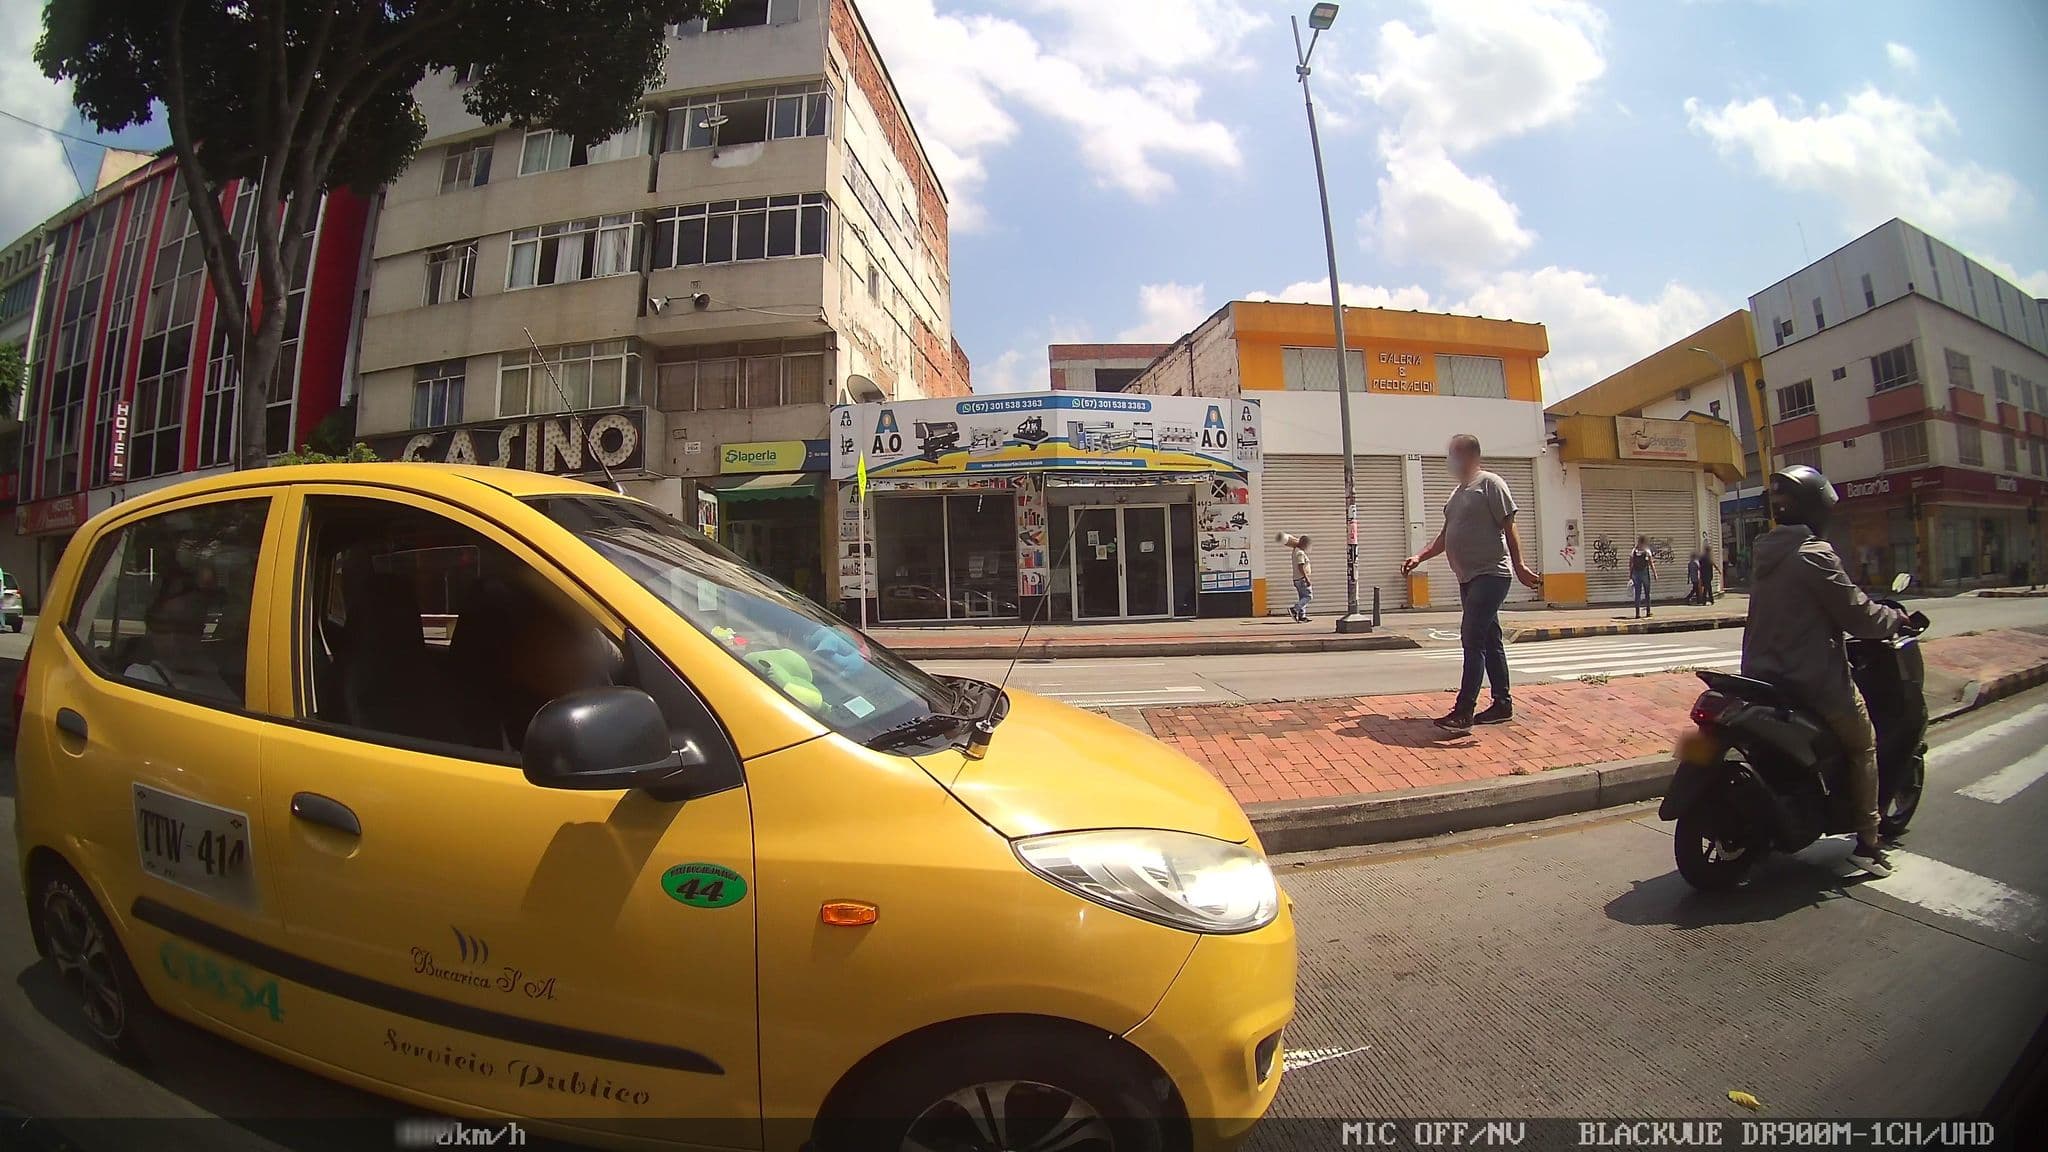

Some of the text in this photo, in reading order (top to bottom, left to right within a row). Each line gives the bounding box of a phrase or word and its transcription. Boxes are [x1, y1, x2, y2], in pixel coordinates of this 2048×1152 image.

[1379, 353, 1422, 365] GALERIA
[972, 403, 988, 413] (57)
[990, 402, 1003, 410] 301
[1081, 399, 1097, 409] (57)
[1098, 400, 1111, 408] 301
[1112, 401, 1126, 409] 538
[114, 403, 129, 467] HOTEL
[402, 414, 638, 472] CASINO
[676, 879, 724, 902] 44
[411, 946, 491, 989] Bucarica
[384, 1028, 650, 1105] Servicio Publico
